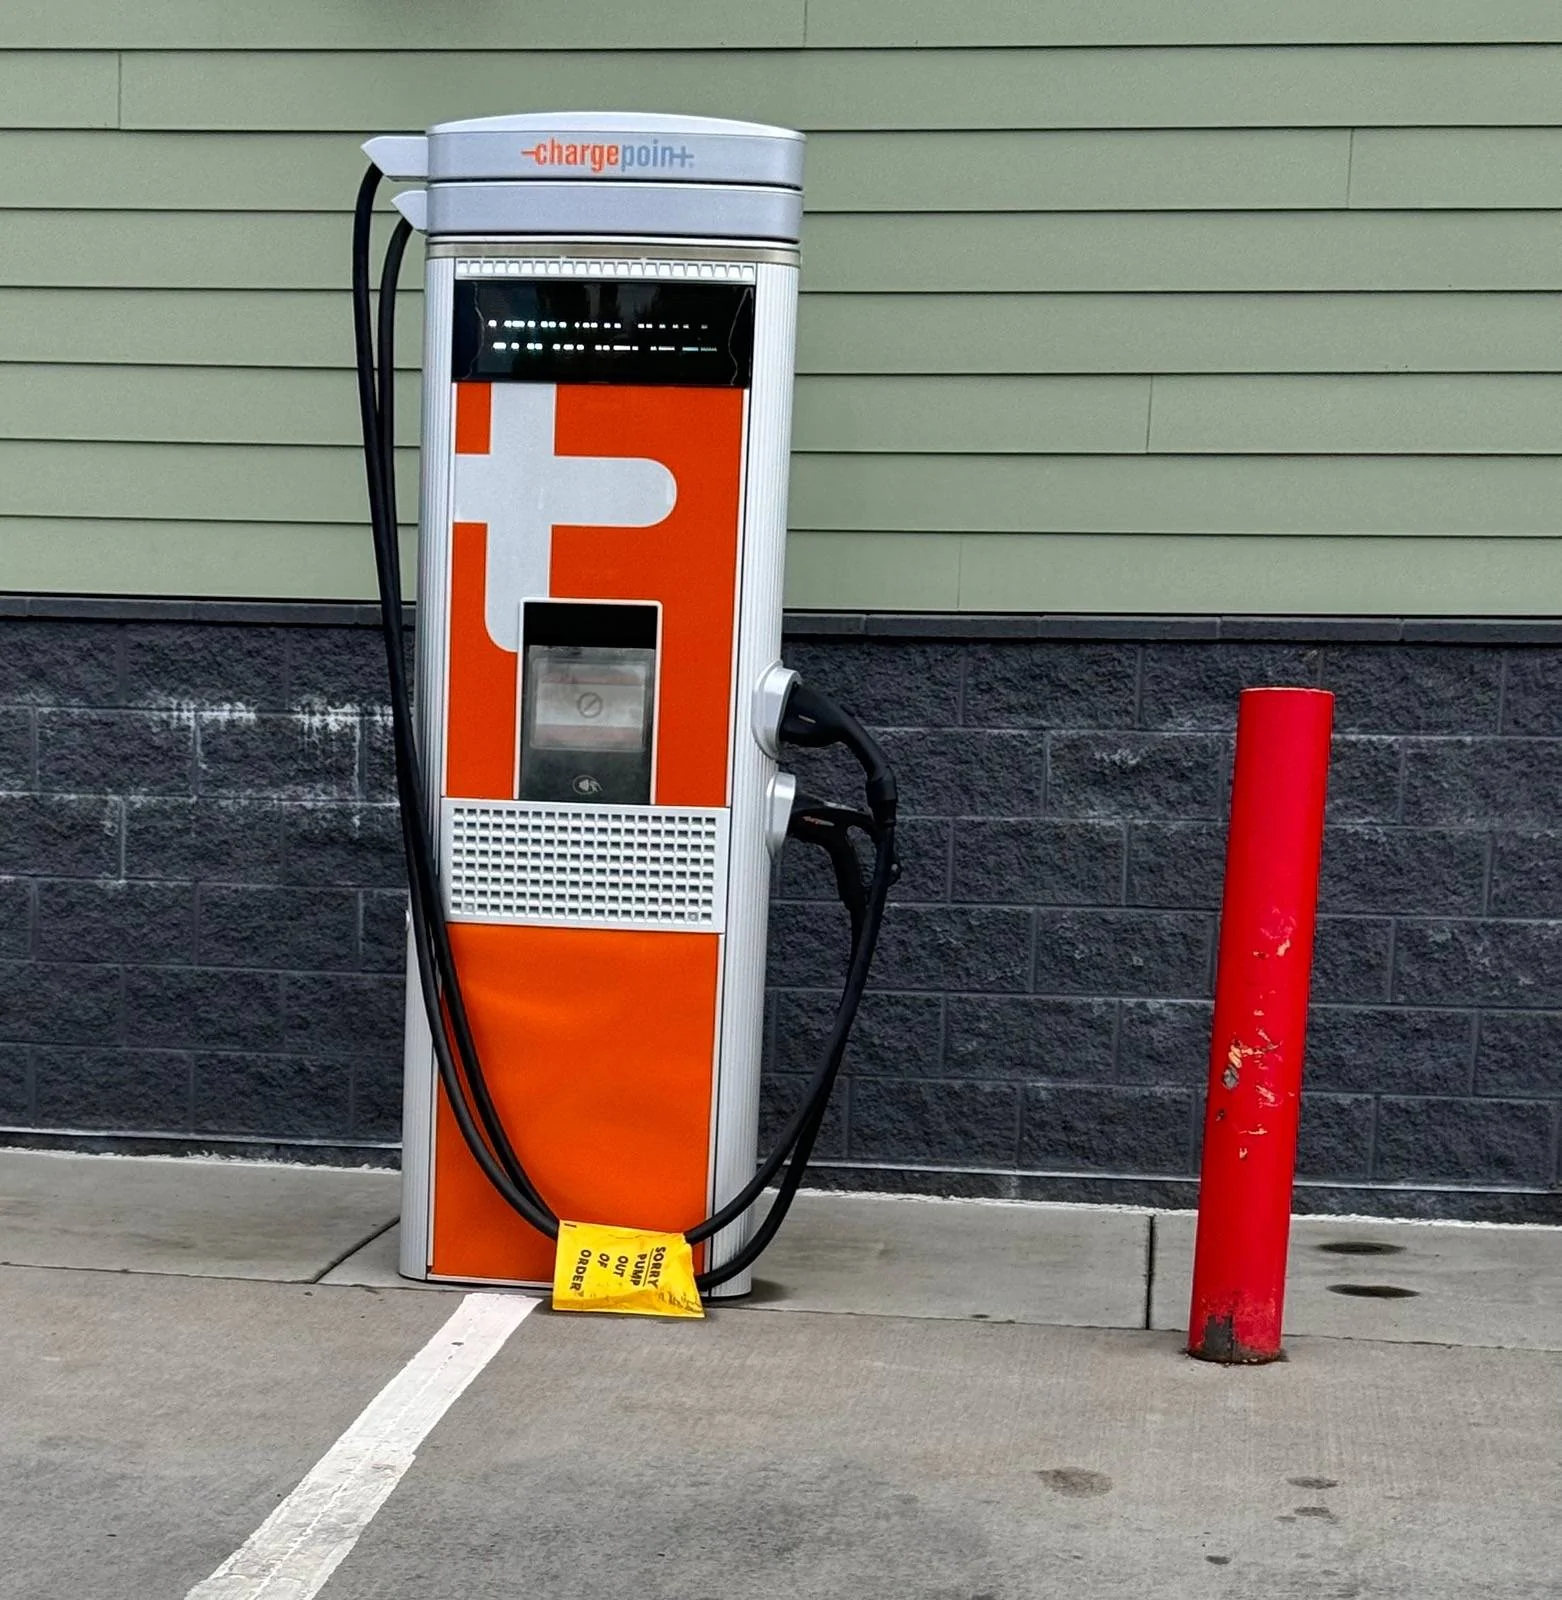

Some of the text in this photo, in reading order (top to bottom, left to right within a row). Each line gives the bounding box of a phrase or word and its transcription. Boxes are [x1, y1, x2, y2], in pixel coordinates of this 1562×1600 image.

[570, 1249, 592, 1291] ORDER
[597, 1252, 610, 1270] OF
[613, 1255, 629, 1277] OUT
[629, 1253, 647, 1286] PUMP
[647, 1246, 666, 1288] SORRY
